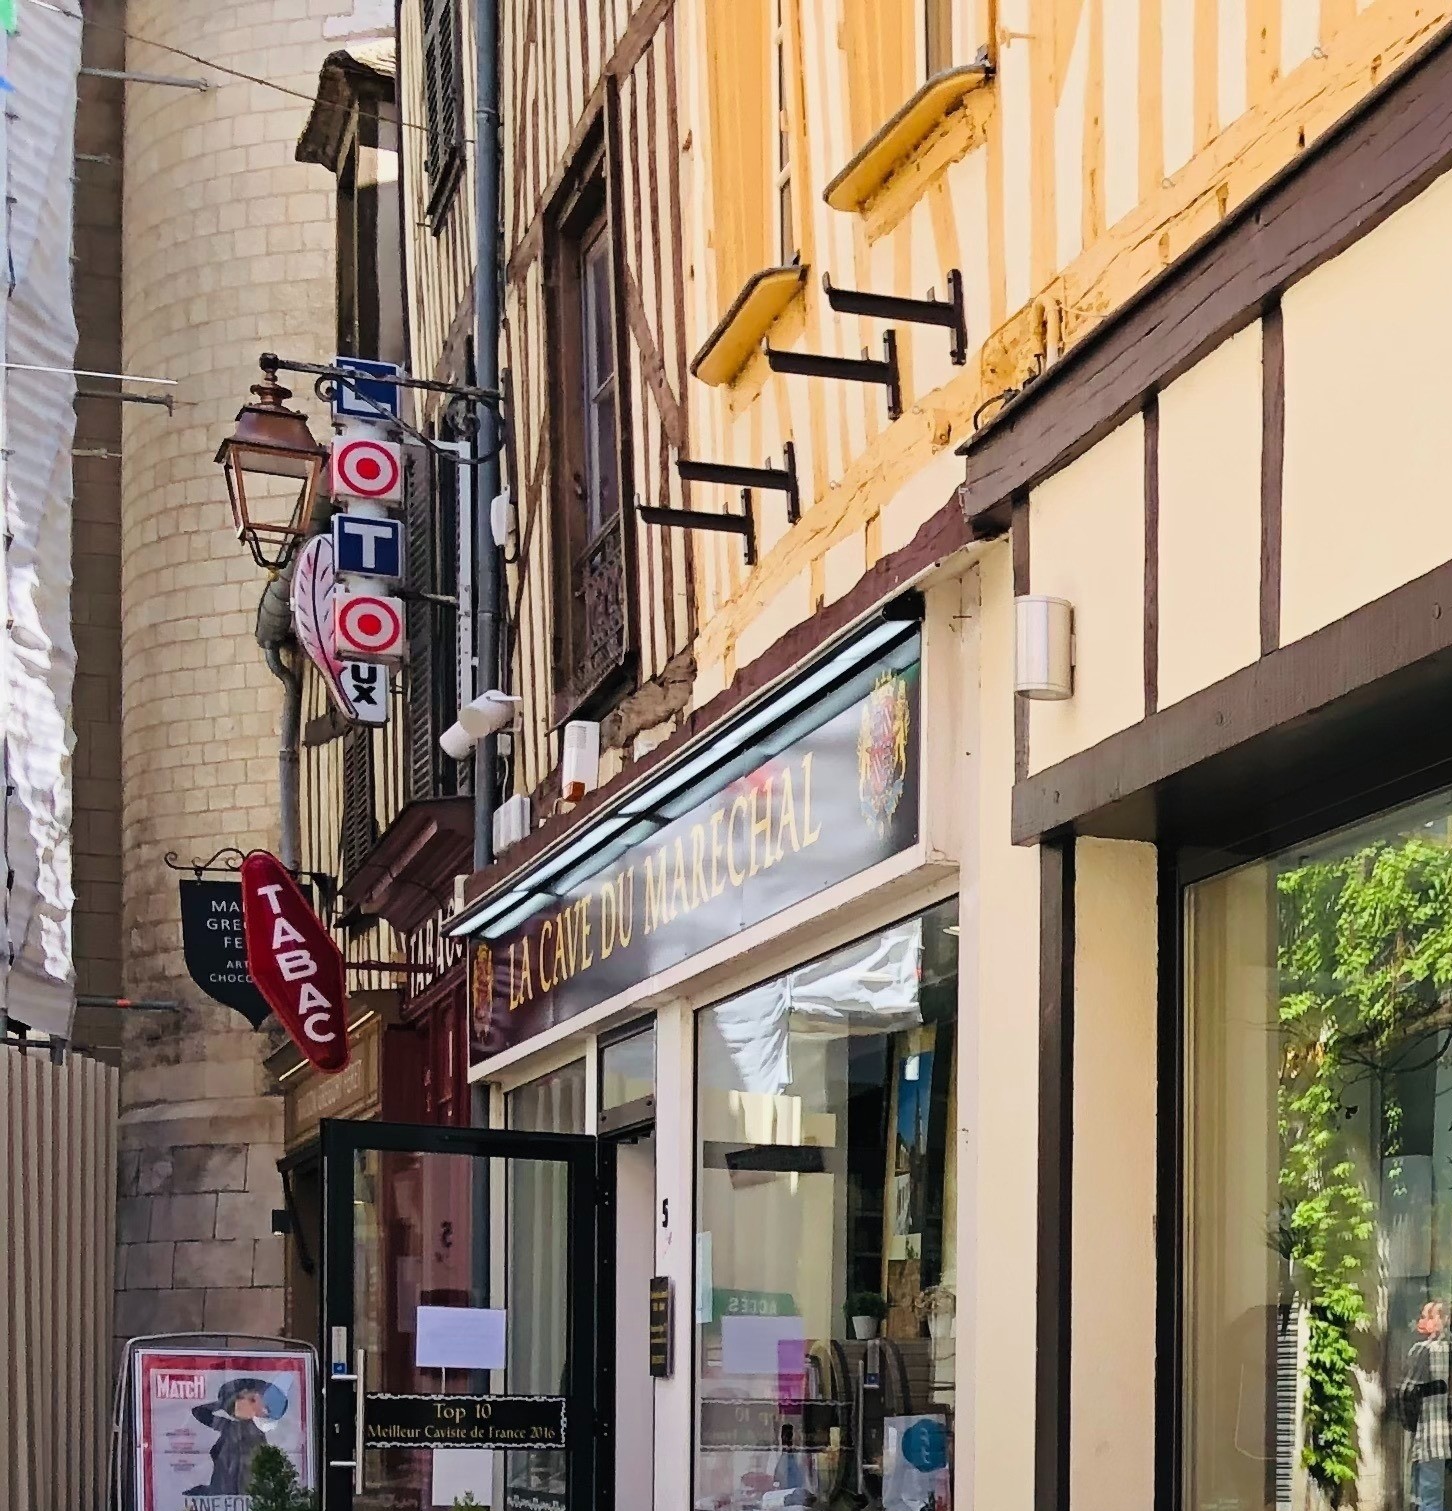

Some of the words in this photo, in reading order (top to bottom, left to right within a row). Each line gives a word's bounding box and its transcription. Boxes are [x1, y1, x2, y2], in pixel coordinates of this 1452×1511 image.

[211, 900, 246, 912] MA
[206, 918, 246, 931] GRE
[223, 936, 244, 949] FE
[507, 944, 534, 1011] LA
[539, 893, 594, 994] CAVE
[600, 869, 635, 960] DU
[257, 884, 336, 1043] TABAC
[433, 1403, 466, 1424] Top
[476, 1403, 492, 1419] 10
[424, 1424, 467, 1439] Caviste
[470, 1425, 485, 1439] de
[489, 1425, 527, 1439] France
